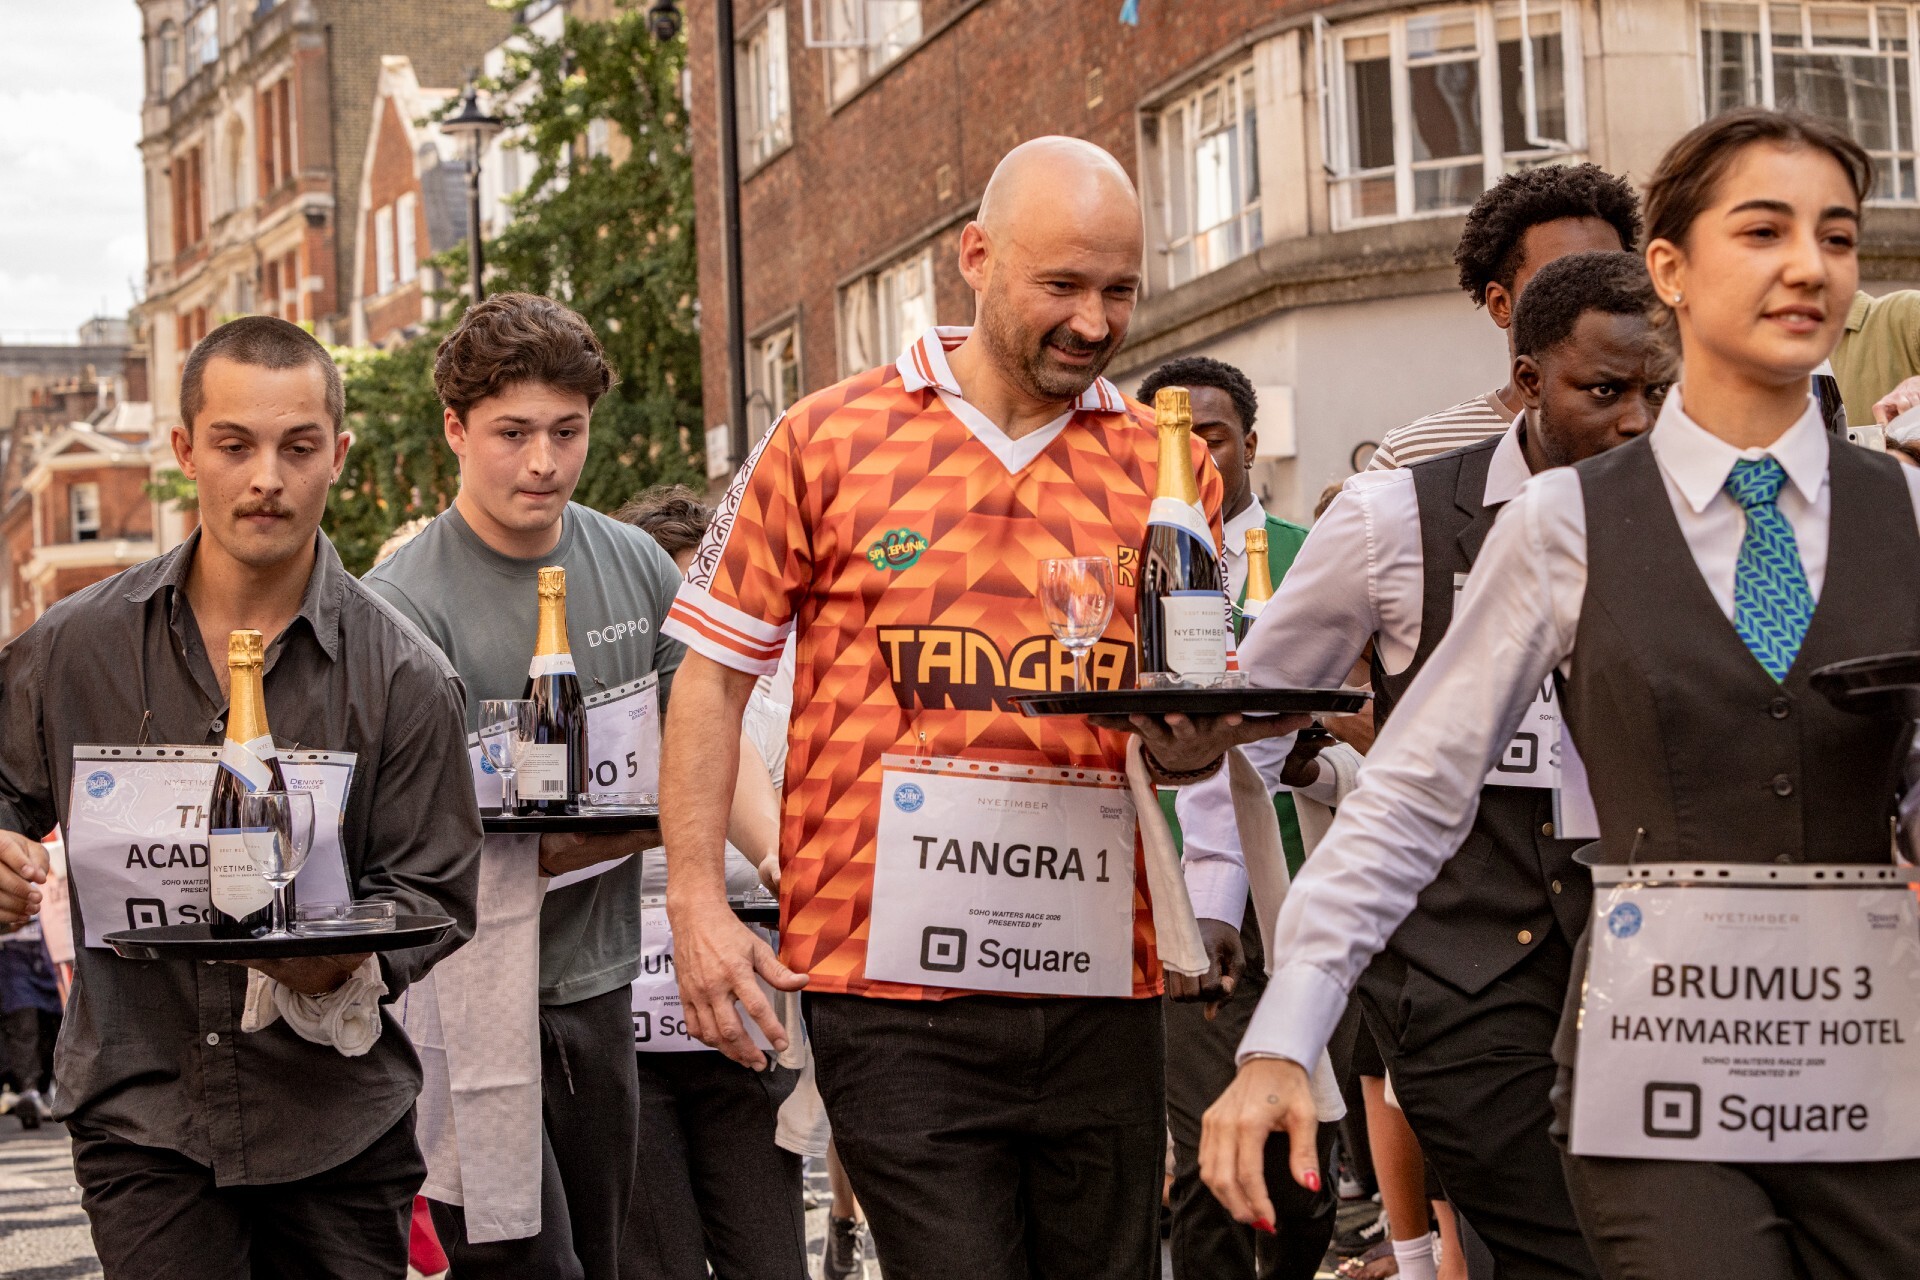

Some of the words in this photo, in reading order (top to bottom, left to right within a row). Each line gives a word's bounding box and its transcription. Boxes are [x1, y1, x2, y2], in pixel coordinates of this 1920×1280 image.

[587, 617, 650, 647] DOPPO
[878, 628, 1129, 692] TANGRA
[588, 760, 618, 787] O
[625, 751, 638, 778] 5
[977, 797, 1049, 810] NYETIMBER
[912, 834, 1086, 882] TANGRA
[1096, 848, 1111, 883] 1
[968, 908, 991, 917] SOHO
[992, 911, 1024, 919] WAITERS
[988, 919, 1031, 928] PRESENTED
[977, 938, 1091, 978] Square
[1652, 964, 1841, 1001] BRUMUS
[1853, 965, 1872, 1000] 3
[1610, 1015, 1811, 1046] HAYMARKET
[1819, 1018, 1905, 1046] HOTEL
[1702, 1056, 1731, 1065] SOHO
[1717, 1094, 1869, 1142] Square
